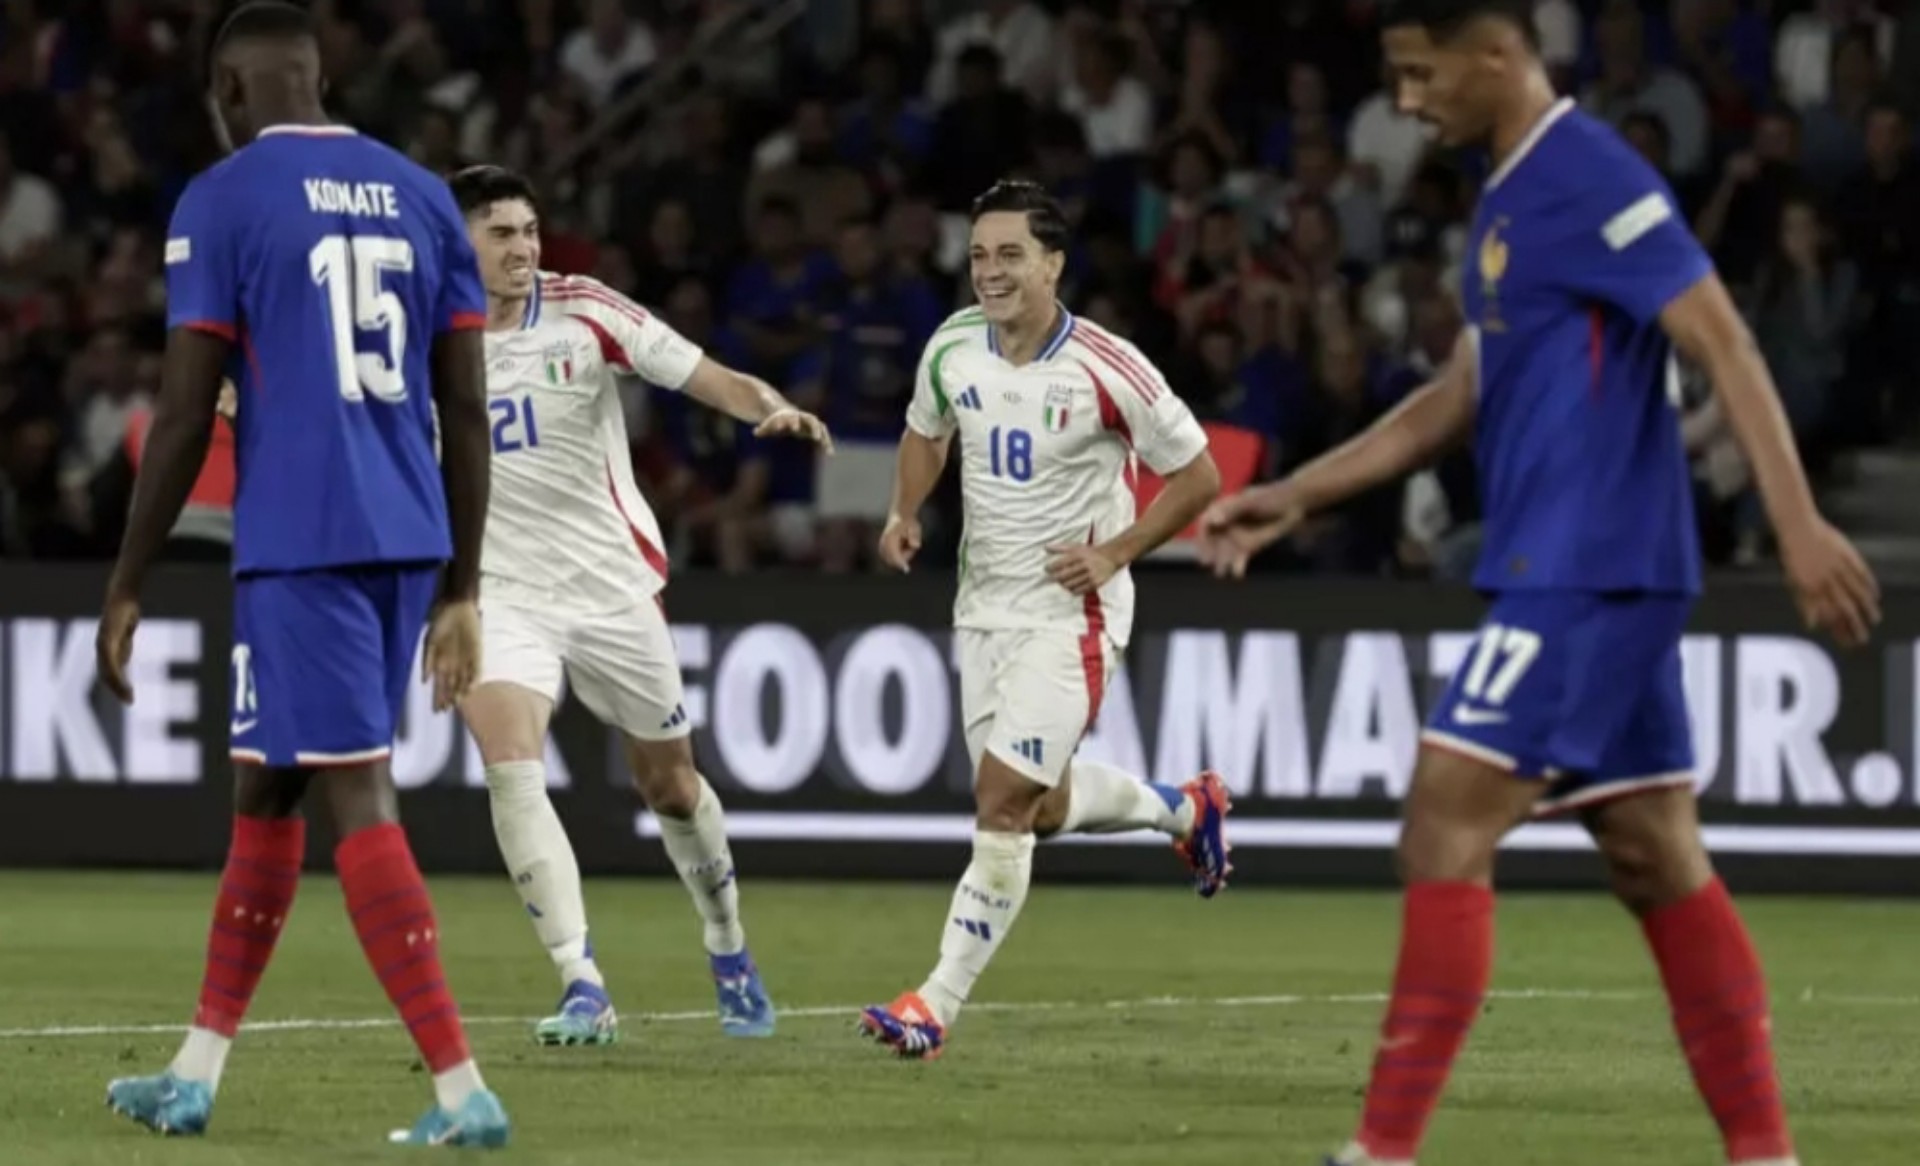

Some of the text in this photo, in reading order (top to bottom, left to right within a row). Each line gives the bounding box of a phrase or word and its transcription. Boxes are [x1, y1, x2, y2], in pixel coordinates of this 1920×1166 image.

[303, 177, 400, 218] KONATE
[308, 234, 415, 404] 15
[488, 393, 539, 454] 21
[989, 424, 1033, 482] 18
[1462, 621, 1543, 706] 17
[0, 616, 203, 786] KE
